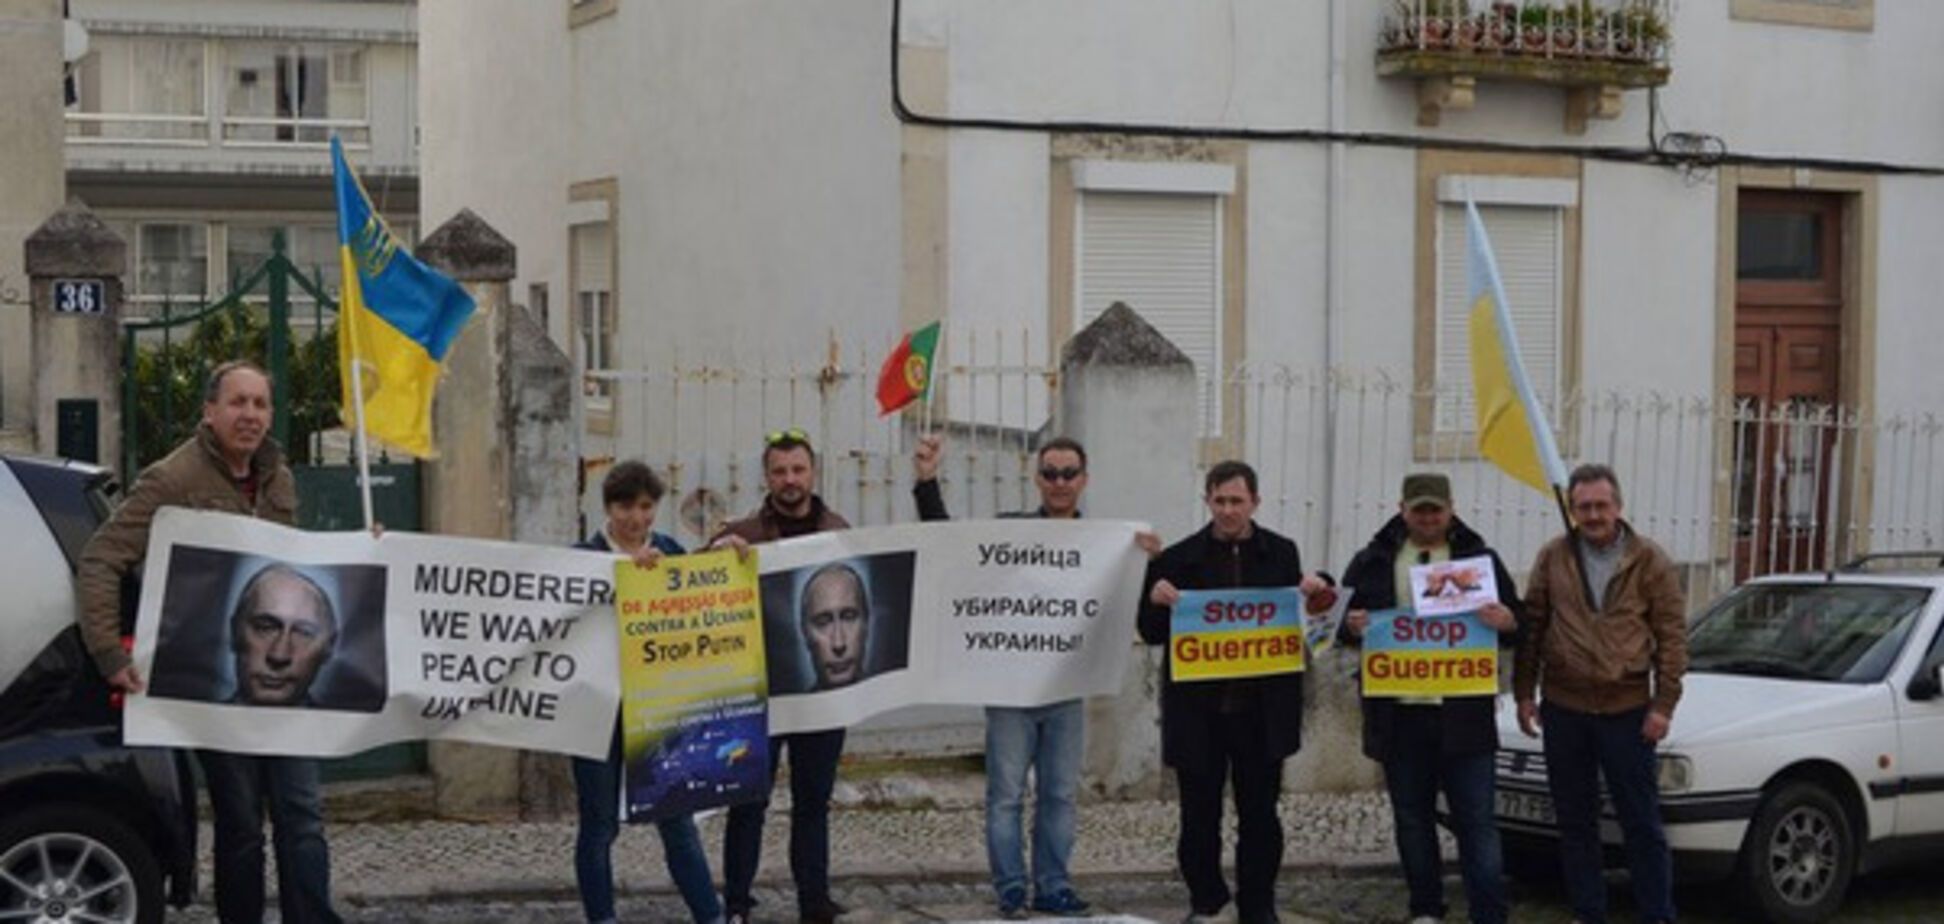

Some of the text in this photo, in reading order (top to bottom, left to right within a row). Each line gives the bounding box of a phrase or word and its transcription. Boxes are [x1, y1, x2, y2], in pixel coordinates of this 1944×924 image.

[61, 284, 95, 312] 36
[978, 542, 1081, 570] Убийца
[666, 567, 729, 591] 3 ANOS
[952, 594, 1100, 618] УБИРАЙСЯ С
[1204, 598, 1277, 626] Stop
[420, 608, 581, 643] WE WANT
[625, 616, 686, 636] CONTRA
[1392, 614, 1468, 648] Stop
[1175, 633, 1300, 664] Guerras
[531, 650, 577, 682] TO
[1367, 653, 1495, 680] Guerras
